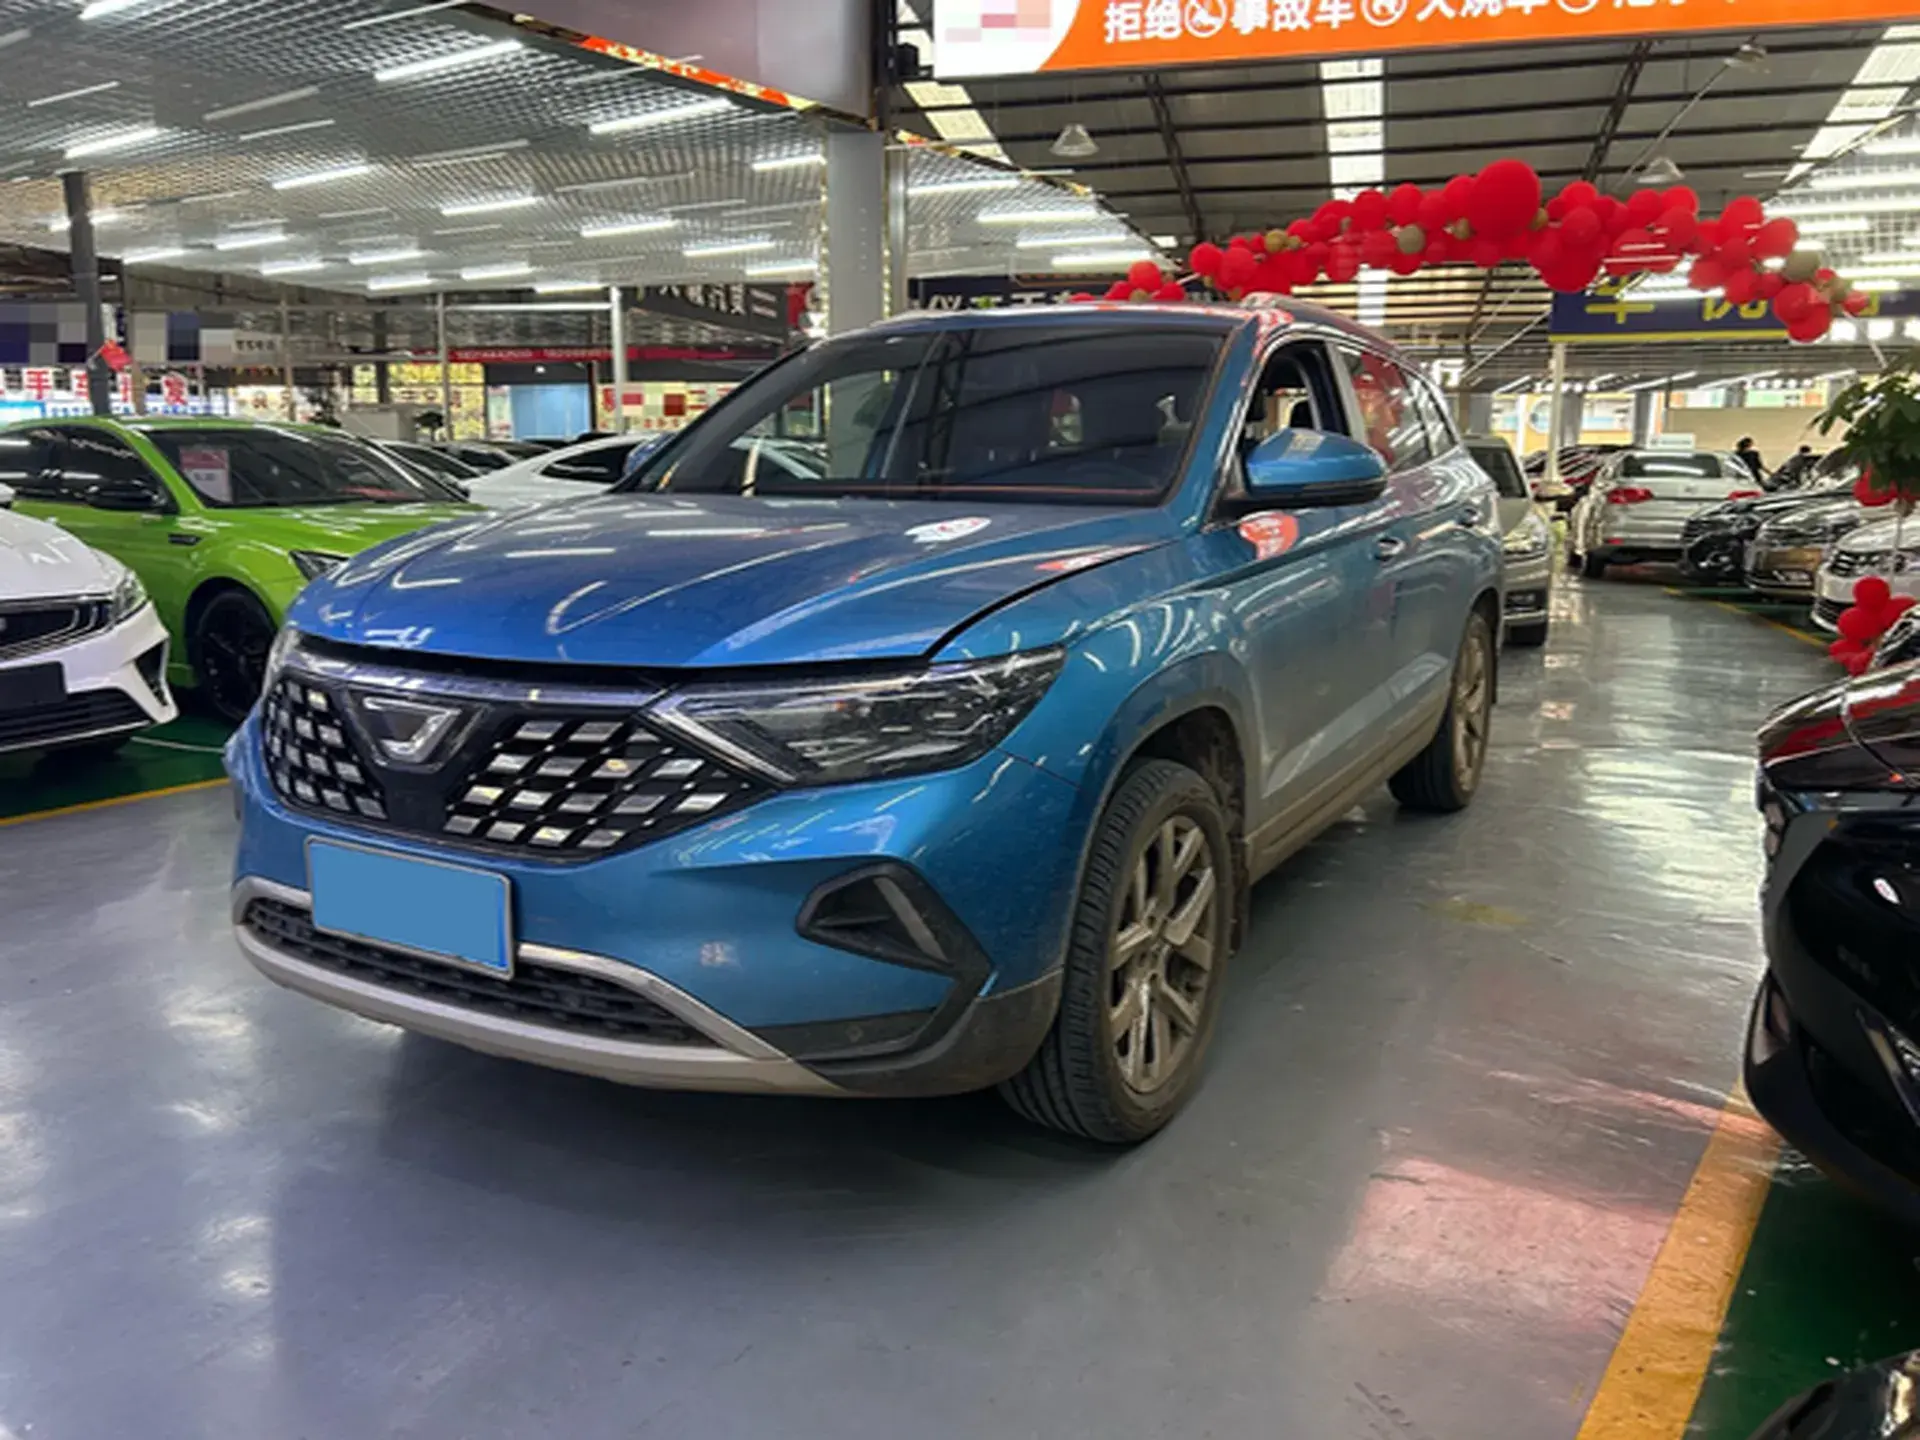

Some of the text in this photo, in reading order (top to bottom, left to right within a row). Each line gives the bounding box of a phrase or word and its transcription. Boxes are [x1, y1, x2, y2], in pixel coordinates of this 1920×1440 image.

[1104, 2, 1184, 43] 拒绝
[1231, 0, 1355, 34] 事故车
